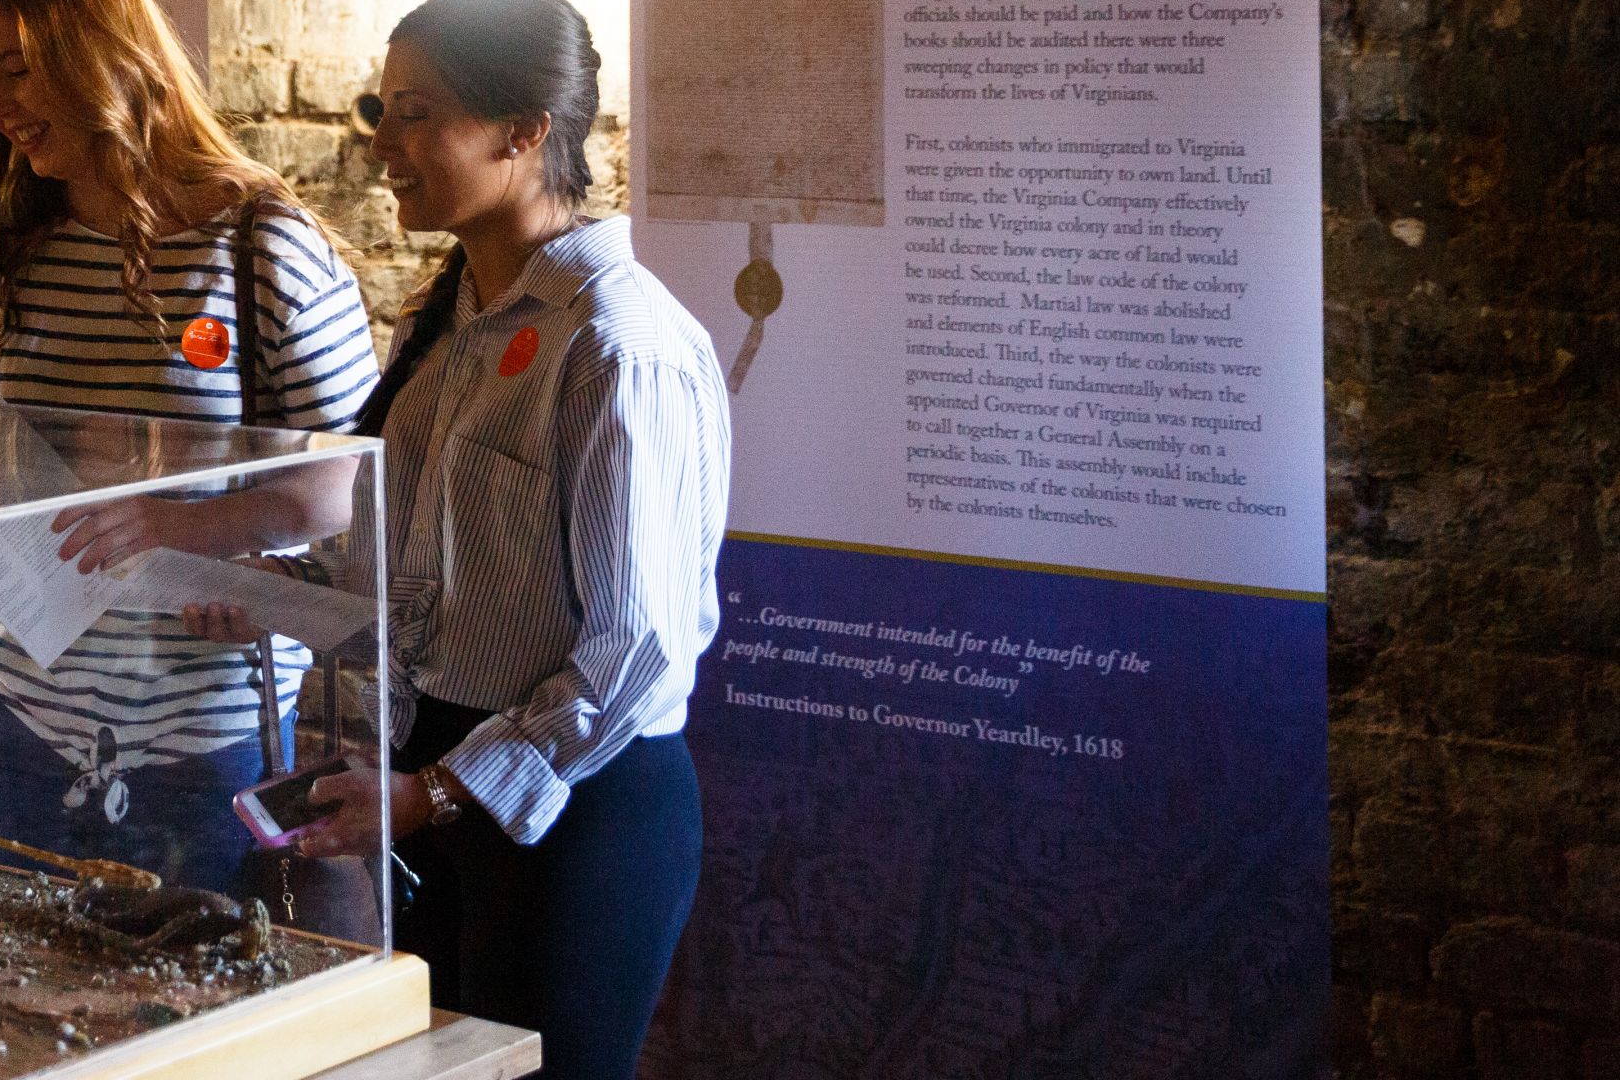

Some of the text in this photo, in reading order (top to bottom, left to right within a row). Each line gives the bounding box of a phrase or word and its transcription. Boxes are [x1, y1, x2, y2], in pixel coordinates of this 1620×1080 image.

[903, 2, 1283, 26] officials should be paid and how the Company's
[905, 133, 1245, 161] First, colonists who immigrated to Virginia
[904, 161, 1272, 185] were given the opportunity to own land. Until
[905, 185, 1249, 217] that time, the Virginia Company effectively
[904, 211, 1223, 243] owned the Virginia colony and in theory
[904, 237, 1238, 266] could decree how every acre of land would
[904, 261, 1248, 299] be used. Second, the law code of the colony
[905, 289, 1231, 320] was reformed. Martial law was abolished
[906, 313, 1243, 349] and elements of English common law were
[906, 340, 1262, 377] introduced. Third, the way the colonists were
[905, 368, 1246, 404] governed changed fundamentally when the
[906, 393, 1262, 435] appointed Governor of Virginia was required
[906, 417, 1226, 458] to call together a General Assembly on a
[906, 443, 1246, 486] periodic basis. This assembly would include
[906, 491, 1117, 528] by the colonists themselves.
[907, 472, 1287, 517] representatives of the colonists that were chosen
[722, 639, 779, 664] people
[782, 645, 819, 664] and
[820, 651, 895, 678] strength
[898, 659, 918, 684] of
[917, 659, 949, 682] the
[877, 621, 954, 648] intended
[956, 629, 987, 656] for
[990, 635, 1021, 656] the
[1024, 639, 1092, 670] benefit
[1095, 649, 1117, 675] of
[1116, 649, 1150, 673] the
[726, 683, 1123, 759] Instructions to Governor Yeardley, 1618
